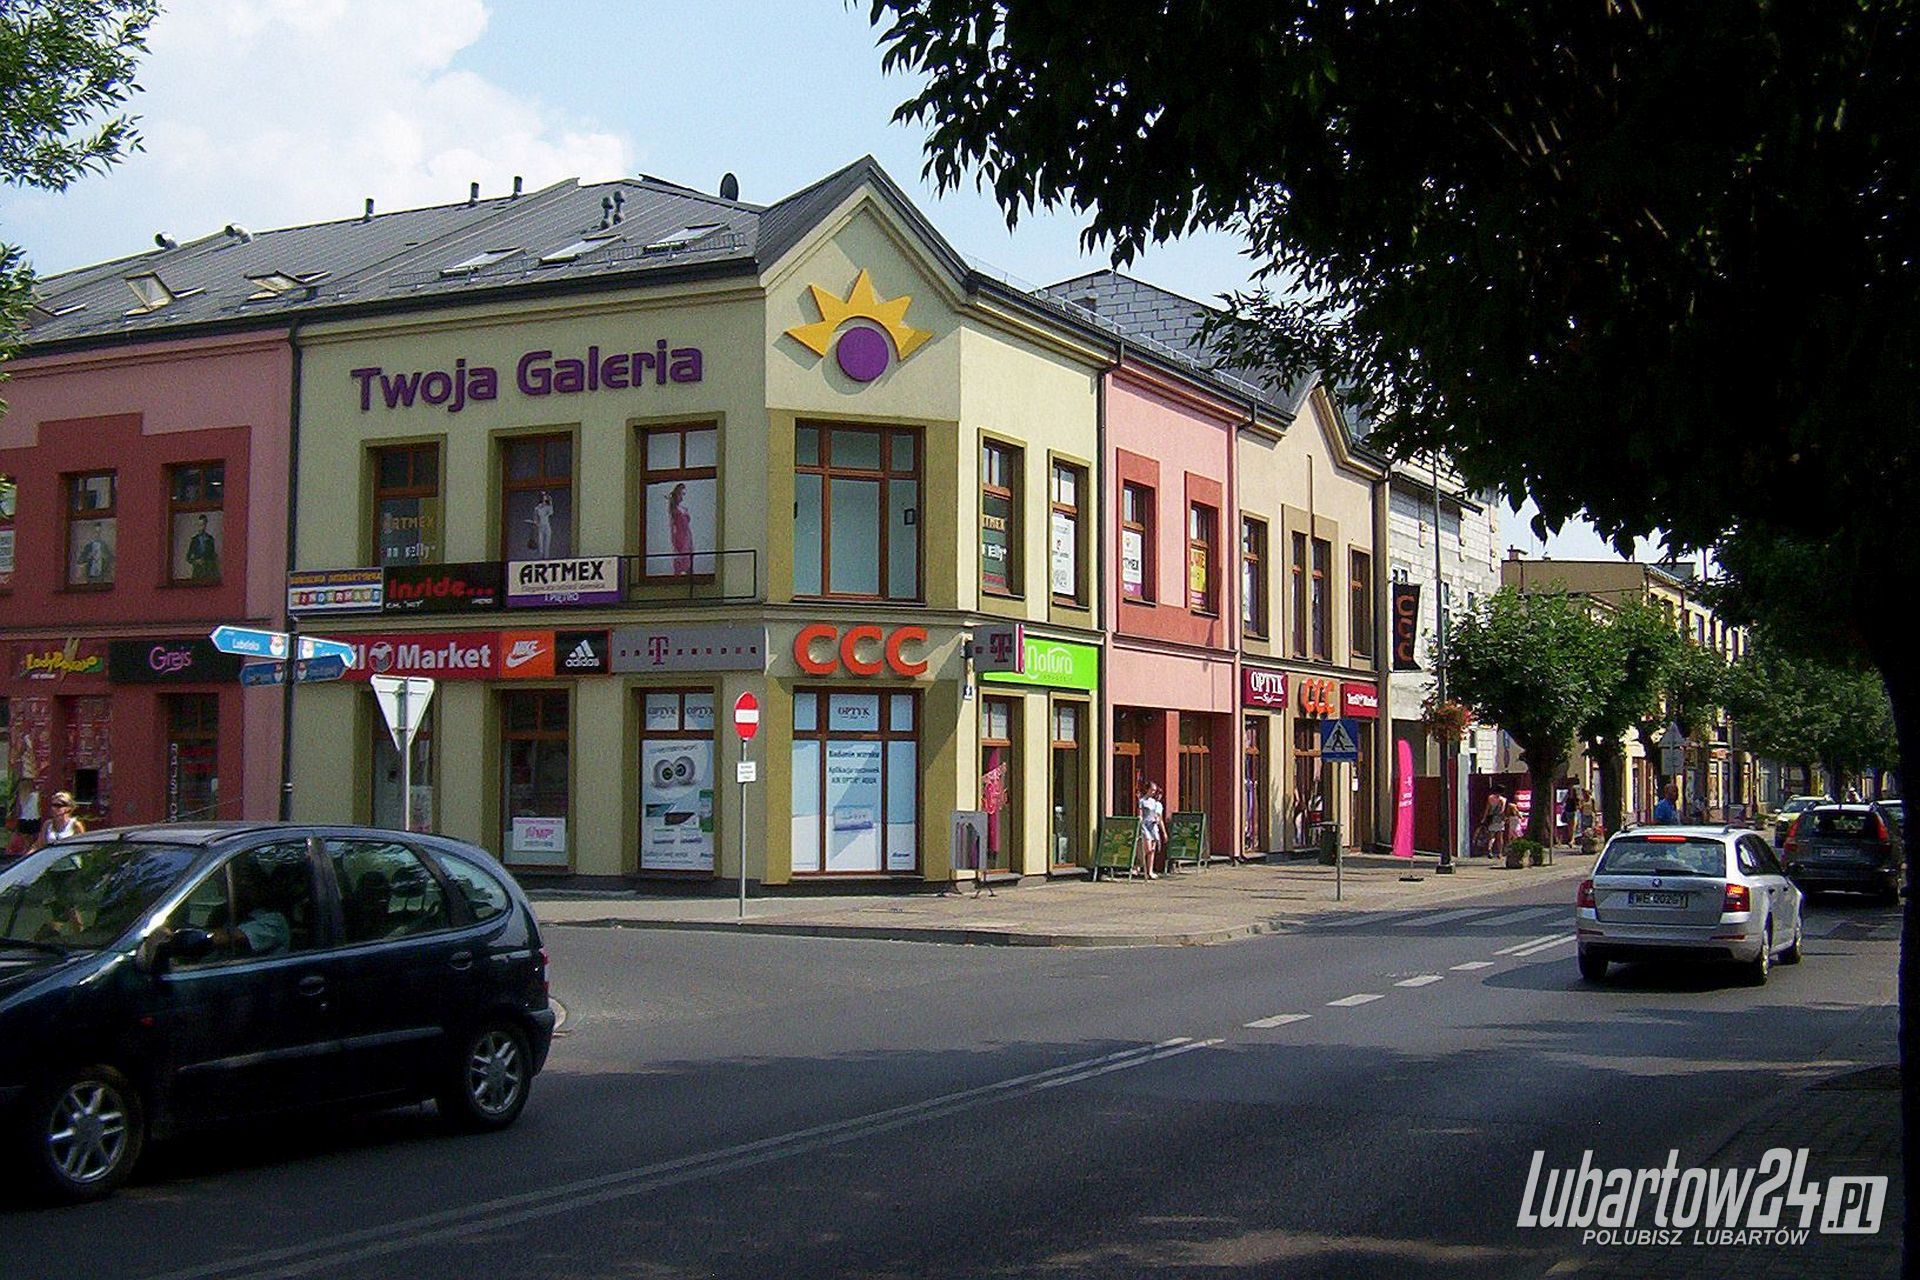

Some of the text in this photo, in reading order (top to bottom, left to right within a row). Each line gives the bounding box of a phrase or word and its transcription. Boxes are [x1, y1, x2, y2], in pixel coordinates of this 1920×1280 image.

[351, 339, 703, 413] Twoja Galeria
[520, 561, 604, 584] ARTMEX
[397, 642, 491, 670] Market
[565, 657, 600, 668] adidas
[793, 623, 928, 676] CCC
[1251, 671, 1284, 694] OPTYK
[1303, 678, 1335, 714] CCC
